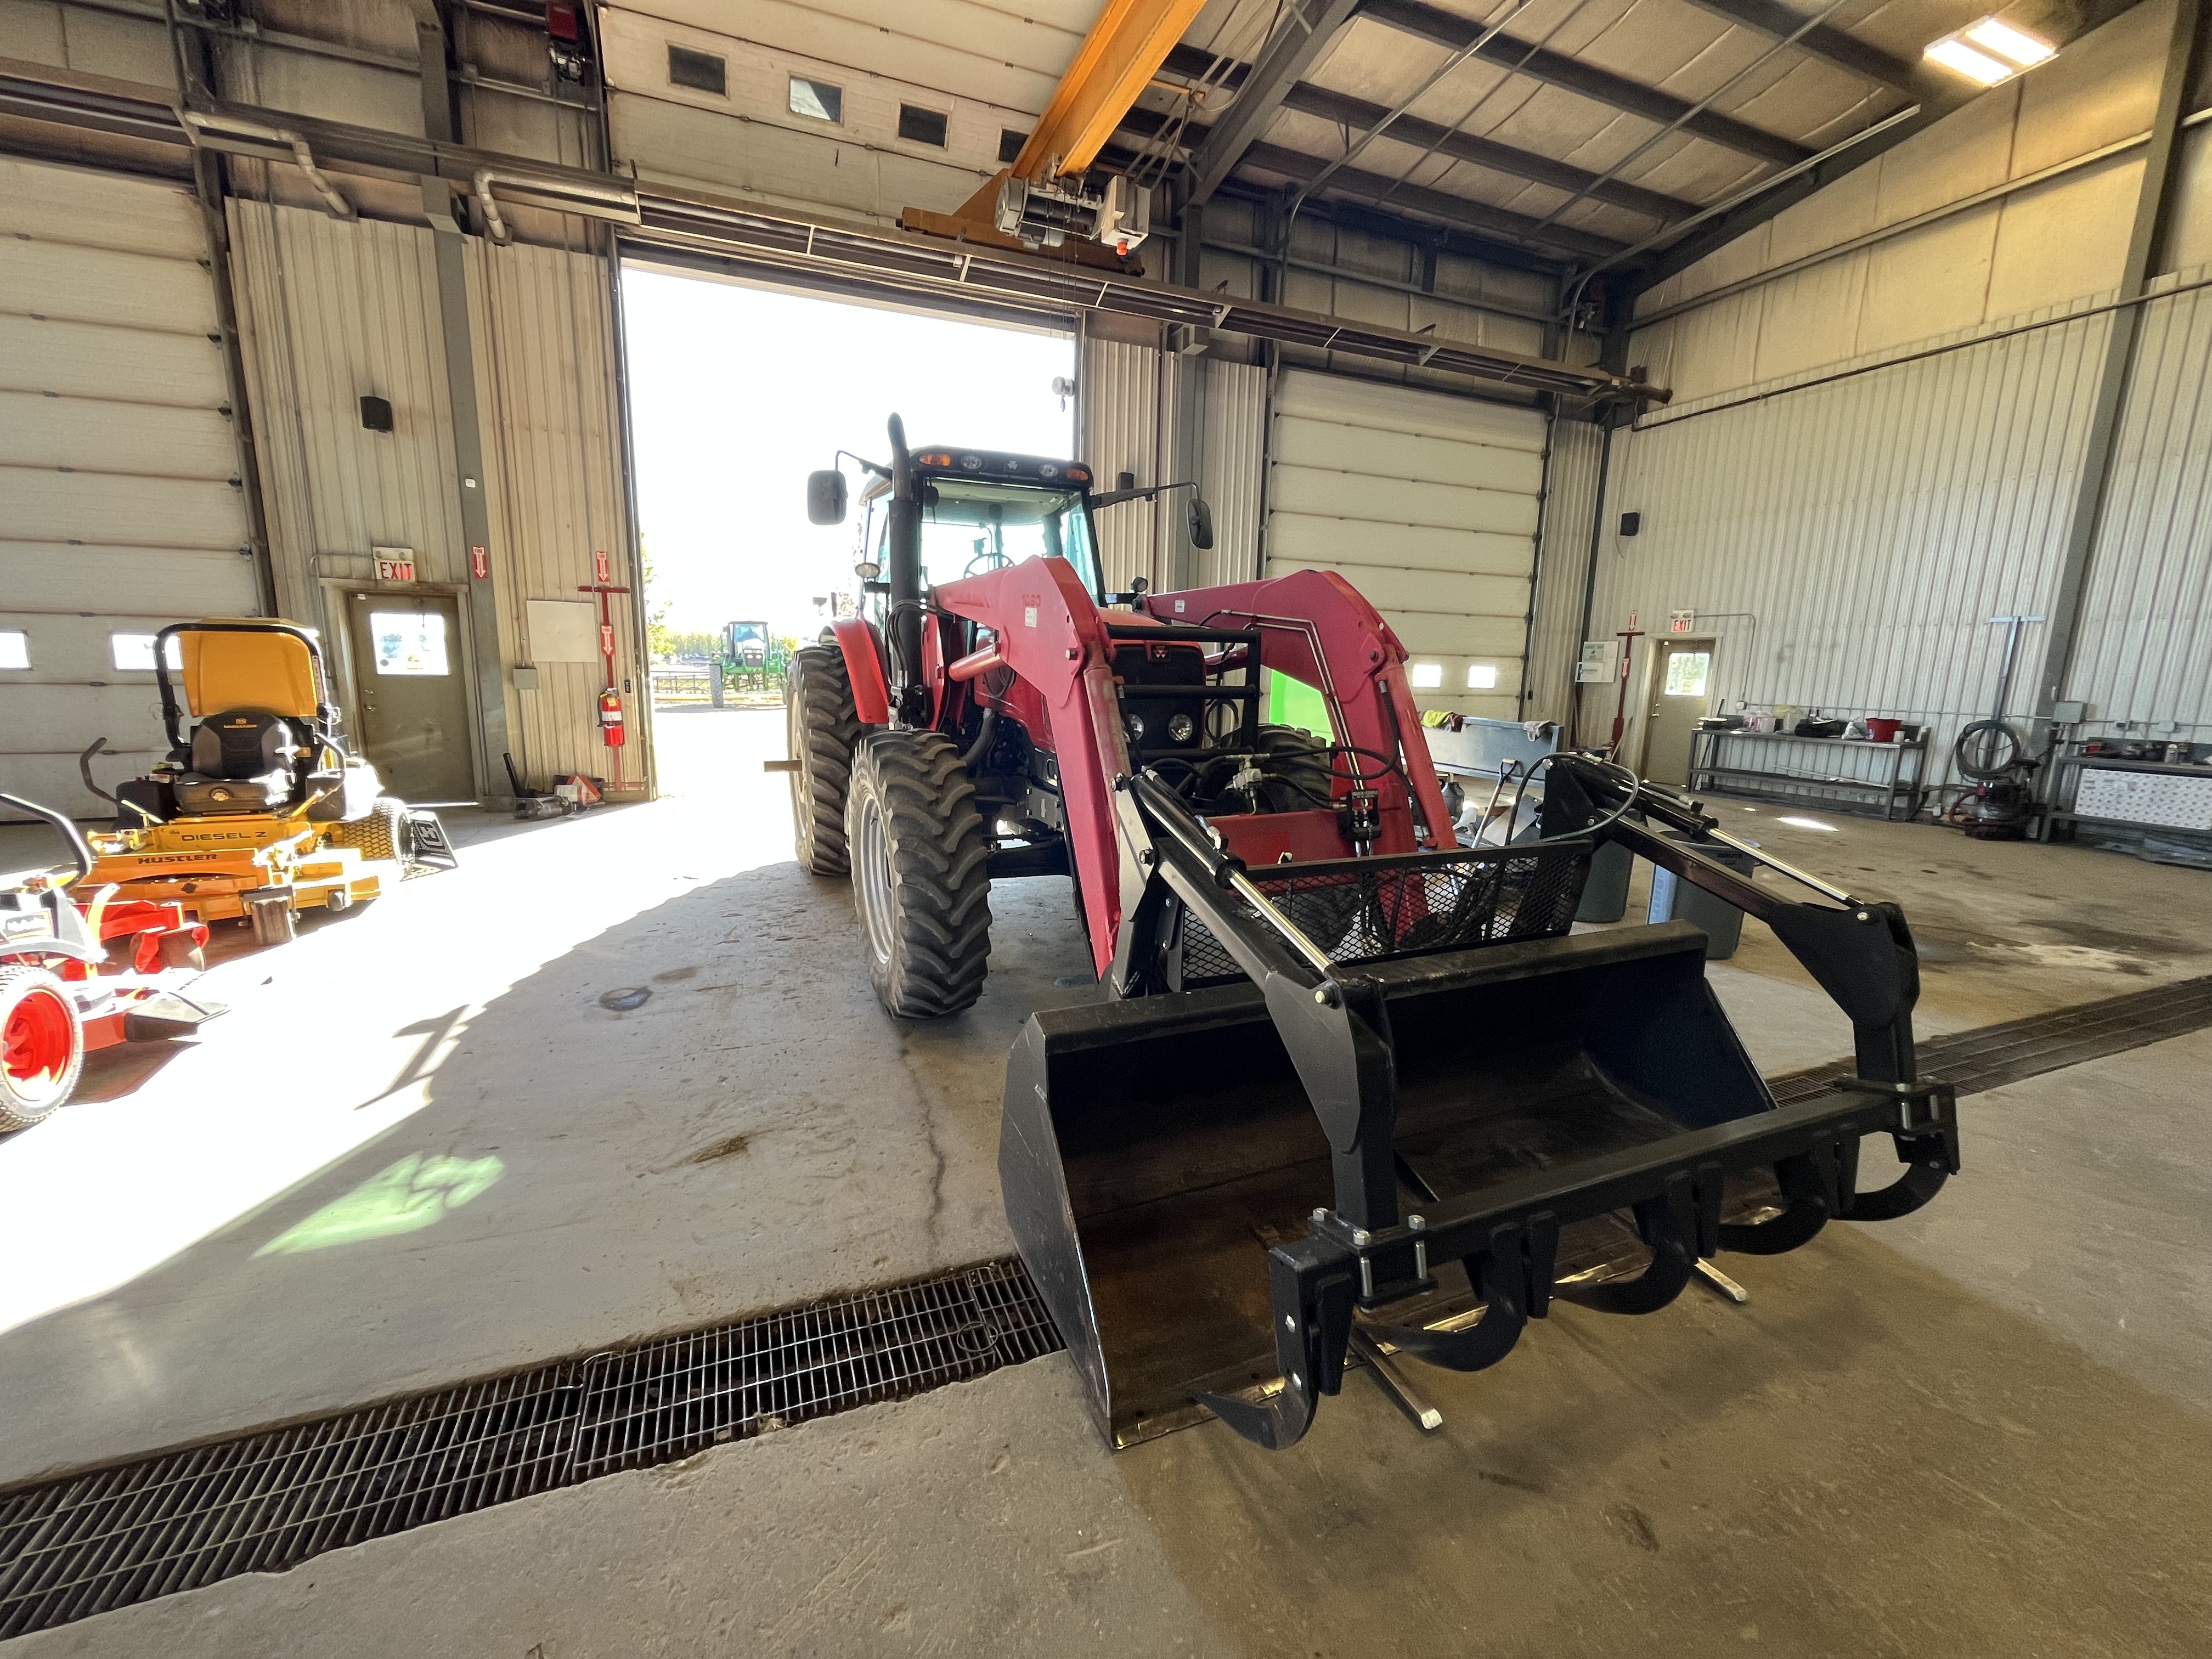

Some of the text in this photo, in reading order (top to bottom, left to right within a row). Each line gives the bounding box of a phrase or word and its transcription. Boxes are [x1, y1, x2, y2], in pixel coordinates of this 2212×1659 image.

[380, 562, 411, 580] EXIT
[1673, 619, 1691, 631] EXIT
[181, 832, 251, 842] DIESEL
[138, 854, 217, 864] HUSTLER
